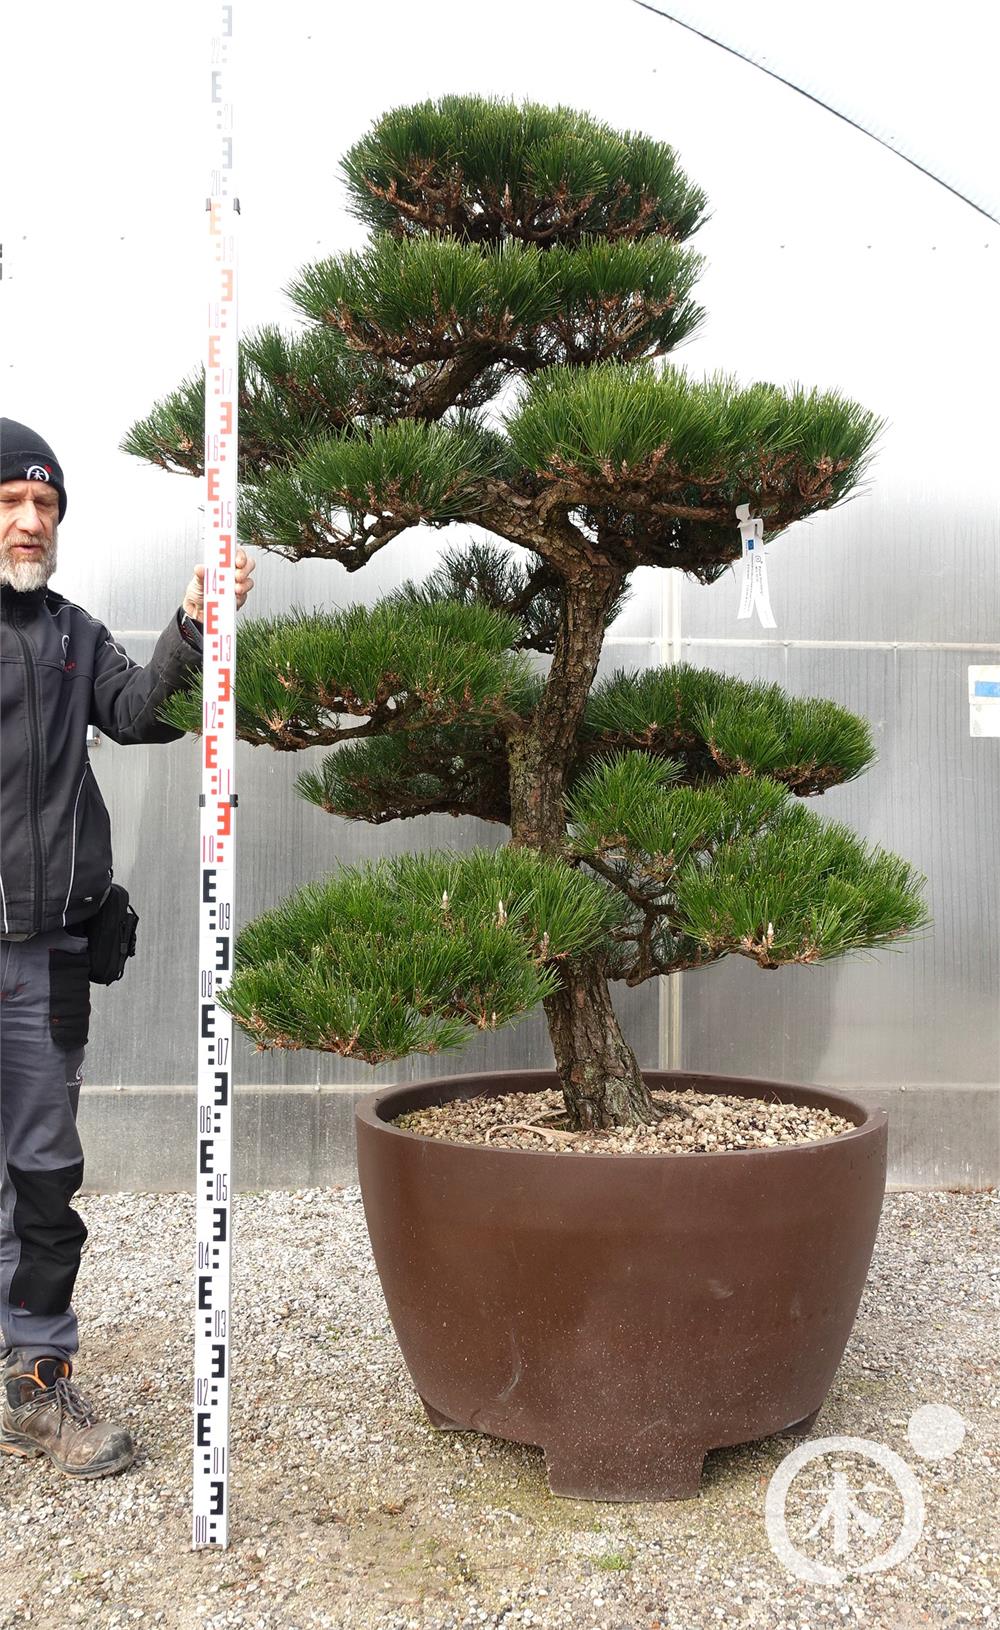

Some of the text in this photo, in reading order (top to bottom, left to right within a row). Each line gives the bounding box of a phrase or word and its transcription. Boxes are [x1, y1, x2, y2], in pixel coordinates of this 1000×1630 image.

[222, 368, 232, 395] 17
[207, 435, 218, 462] 16
[221, 501, 232, 528] 15
[206, 568, 216, 595] 14
[220, 635, 231, 662] 13
[205, 701, 216, 729] 12
[219, 768, 229, 795] 11
[203, 835, 213, 863] 10
[219, 903, 230, 930] 09
[202, 970, 212, 997] 08
[218, 1038, 228, 1065] 07
[200, 1106, 211, 1133] 06
[216, 1174, 227, 1201] 05
[199, 1242, 209, 1269] 04
[215, 1310, 226, 1337] 03
[197, 1378, 208, 1406] 02
[214, 1447, 224, 1474] 01
[196, 1515, 206, 1543] 00
